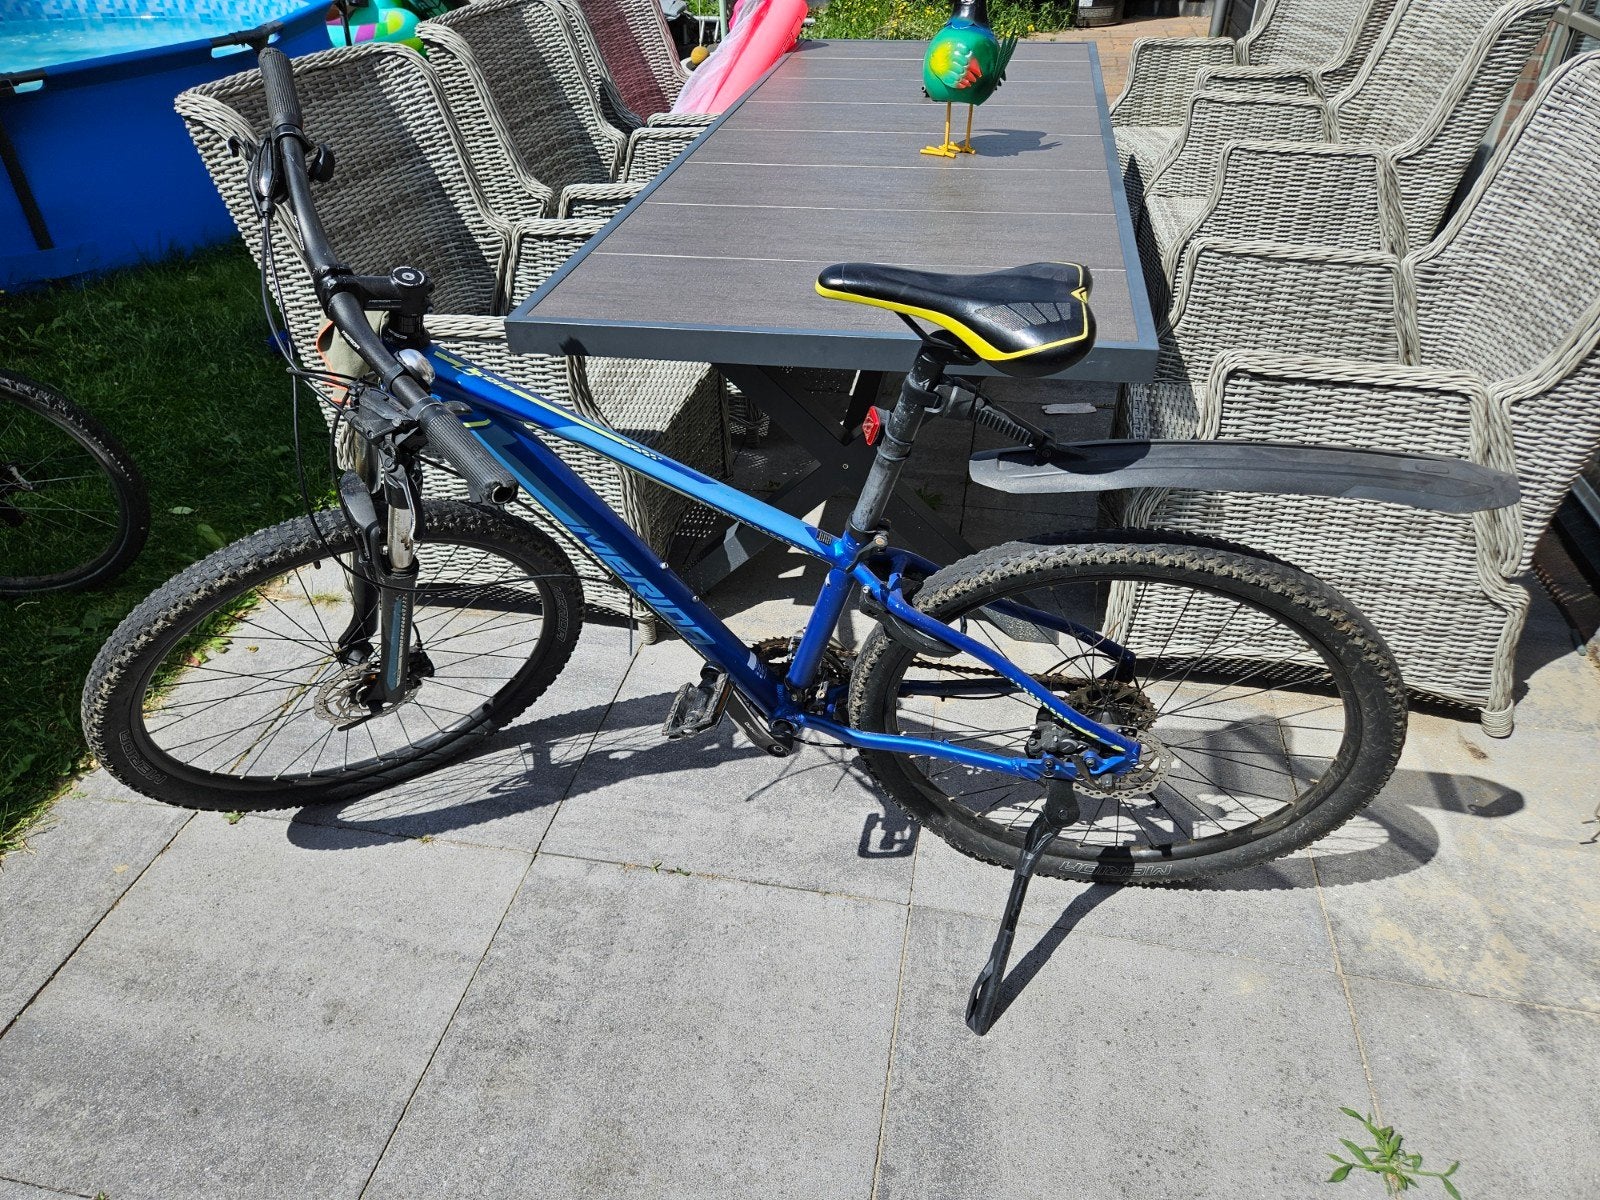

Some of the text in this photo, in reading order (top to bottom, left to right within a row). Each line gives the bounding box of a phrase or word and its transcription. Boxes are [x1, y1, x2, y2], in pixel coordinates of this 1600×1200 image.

[566, 524, 716, 646] MERIDA
[119, 730, 167, 784] MERIDA
[1059, 861, 1173, 877] MERIDA
